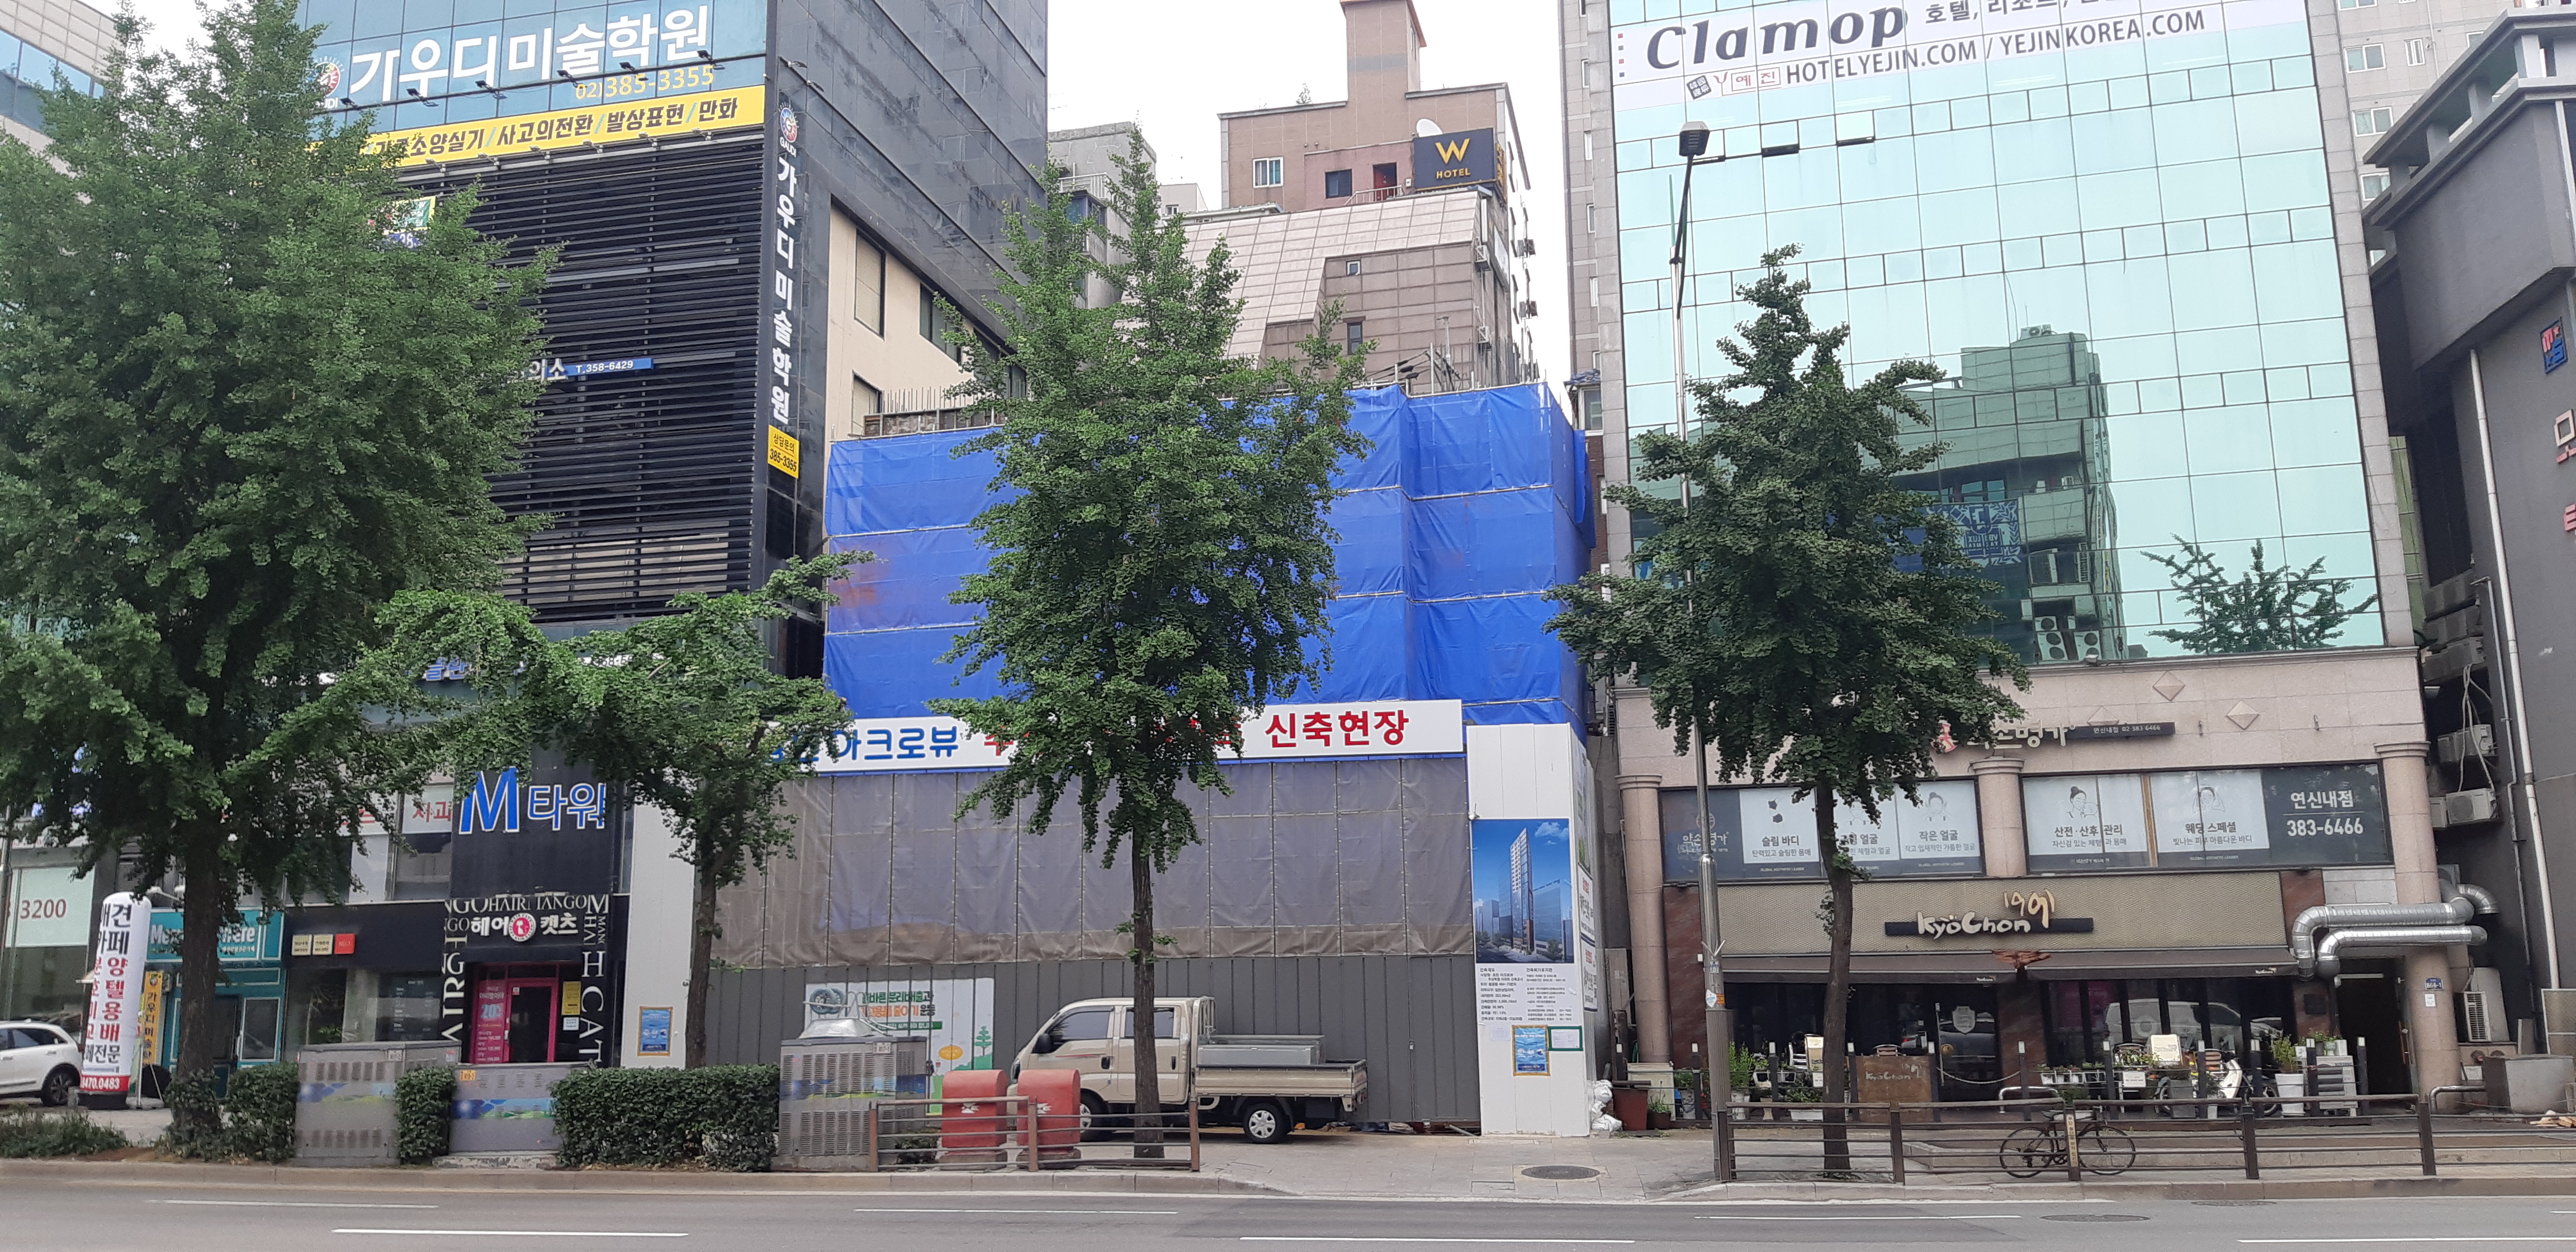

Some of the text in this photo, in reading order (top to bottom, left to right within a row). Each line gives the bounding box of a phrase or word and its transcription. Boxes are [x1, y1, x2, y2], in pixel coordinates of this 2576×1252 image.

[1925, 1, 1978, 23] 호텔,
[1647, 6, 1909, 70] Clamop
[1786, 40, 1977, 84] HOTELYEJIN.COM
[1999, 10, 2205, 56] YEJINKOREA.COM
[349, 5, 709, 102] 가우디미술학원
[576, 65, 714, 99] 02)385-3355
[376, 97, 738, 157] 소양실기 사고의전환 발상표현 만화
[779, 136, 797, 158] GAUDI
[1435, 138, 1470, 165] W
[1436, 168, 1471, 179] HOTEL
[771, 156, 797, 425] 가우디미술학원
[575, 360, 634, 374] T.358-6429
[769, 448, 797, 473] 385-3355
[1265, 709, 1409, 748] 신축현장
[2290, 789, 2354, 809] 연신내점
[1919, 829, 1958, 842] 작은 얼굴
[2103, 824, 2123, 835] 관리
[2185, 822, 2237, 834] 웨딩 스페셜
[2286, 817, 2364, 837] 383-6466
[1761, 835, 1800, 847] 슬림 바디
[1860, 833, 1878, 845] 얼굴
[1918, 844, 1942, 852] 입체적인
[2052, 840, 2072, 848] 자신감
[2173, 837, 2193, 846] 빛나는
[2209, 835, 2237, 845] 아름다운
[2238, 834, 2252, 843] 바디
[1778, 848, 1797, 857] 슬림한
[1878, 847, 1891, 855] 얼굴
[20, 898, 67, 919] 3200
[2004, 888, 2055, 929] 1991
[471, 916, 509, 937] 헤어
